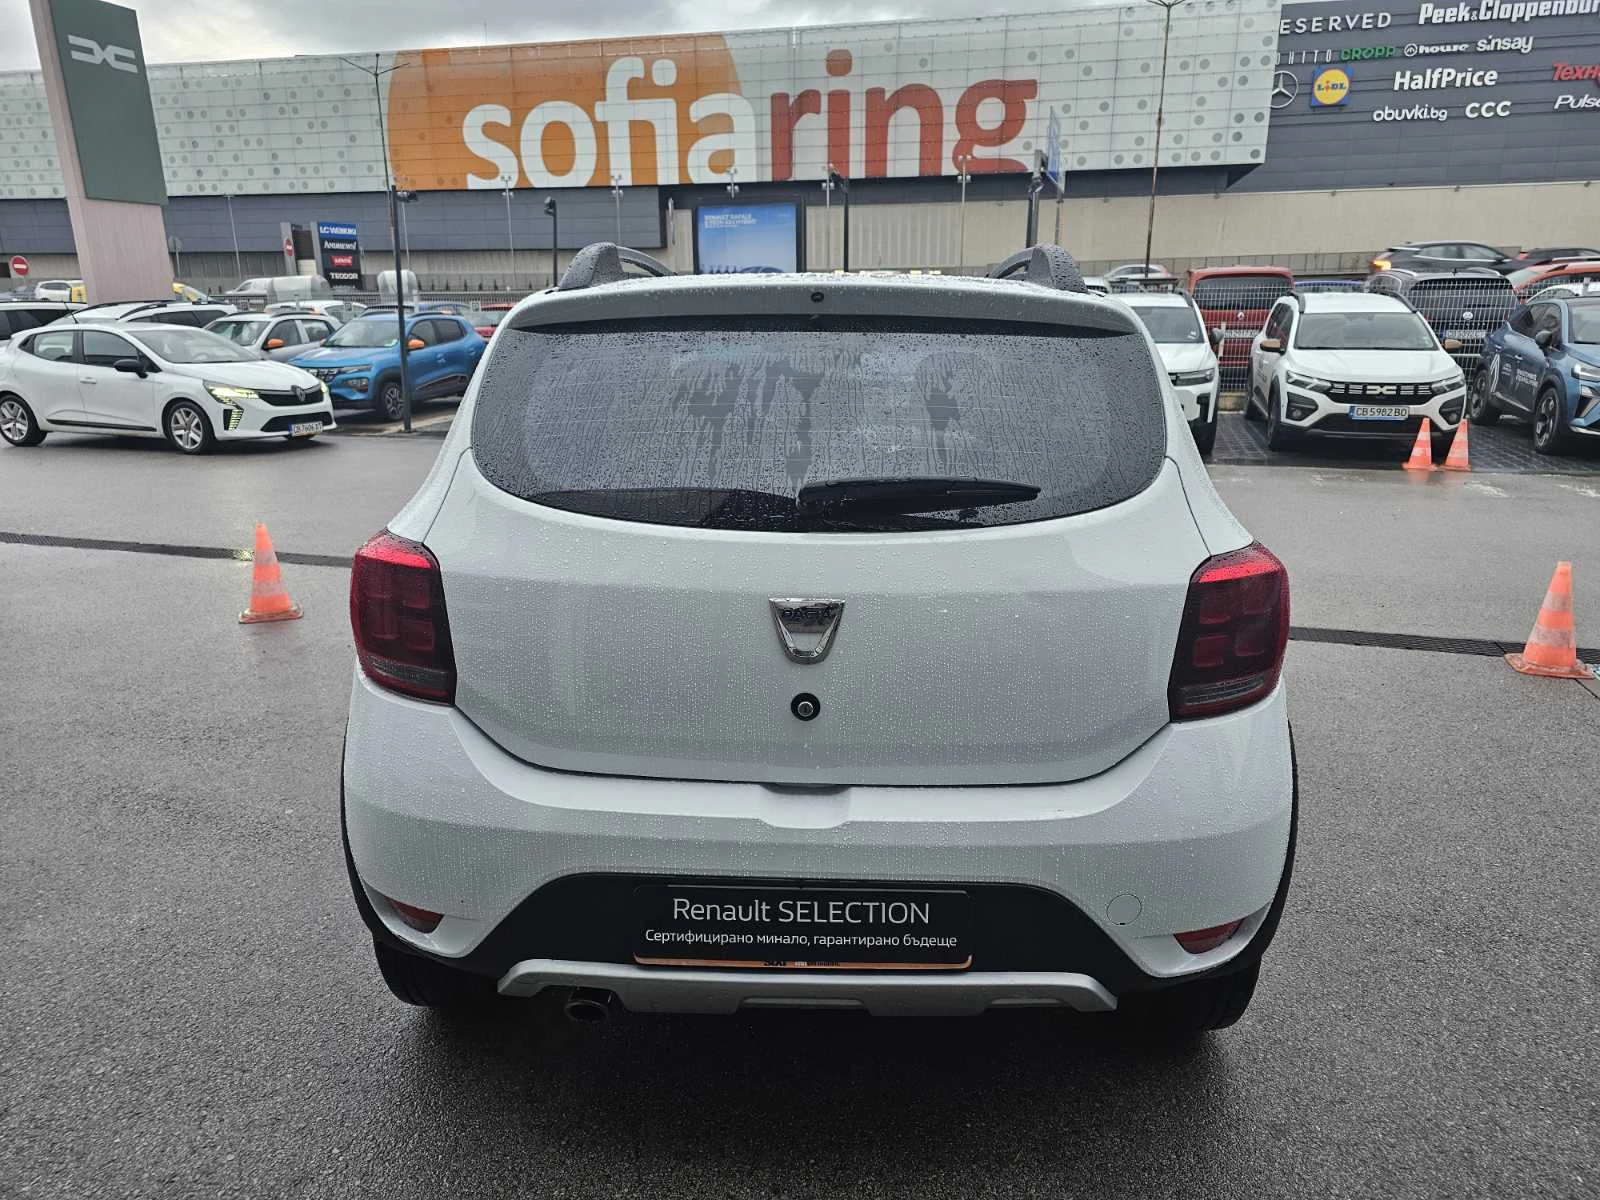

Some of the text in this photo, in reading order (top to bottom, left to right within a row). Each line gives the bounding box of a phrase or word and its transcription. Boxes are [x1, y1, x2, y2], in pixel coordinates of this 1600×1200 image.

[1418, 0, 1600, 25] Peek&Cloppenbur
[1476, 35, 1534, 54] sinsay
[1393, 67, 1498, 91] HalfPrice
[1372, 104, 1448, 122] obuvki.bg
[1465, 101, 1511, 118] CCC
[672, 897, 931, 925] Renault SELECTION
[645, 929, 958, 949] Сертифицирано минало, гарантирано бъдеще
